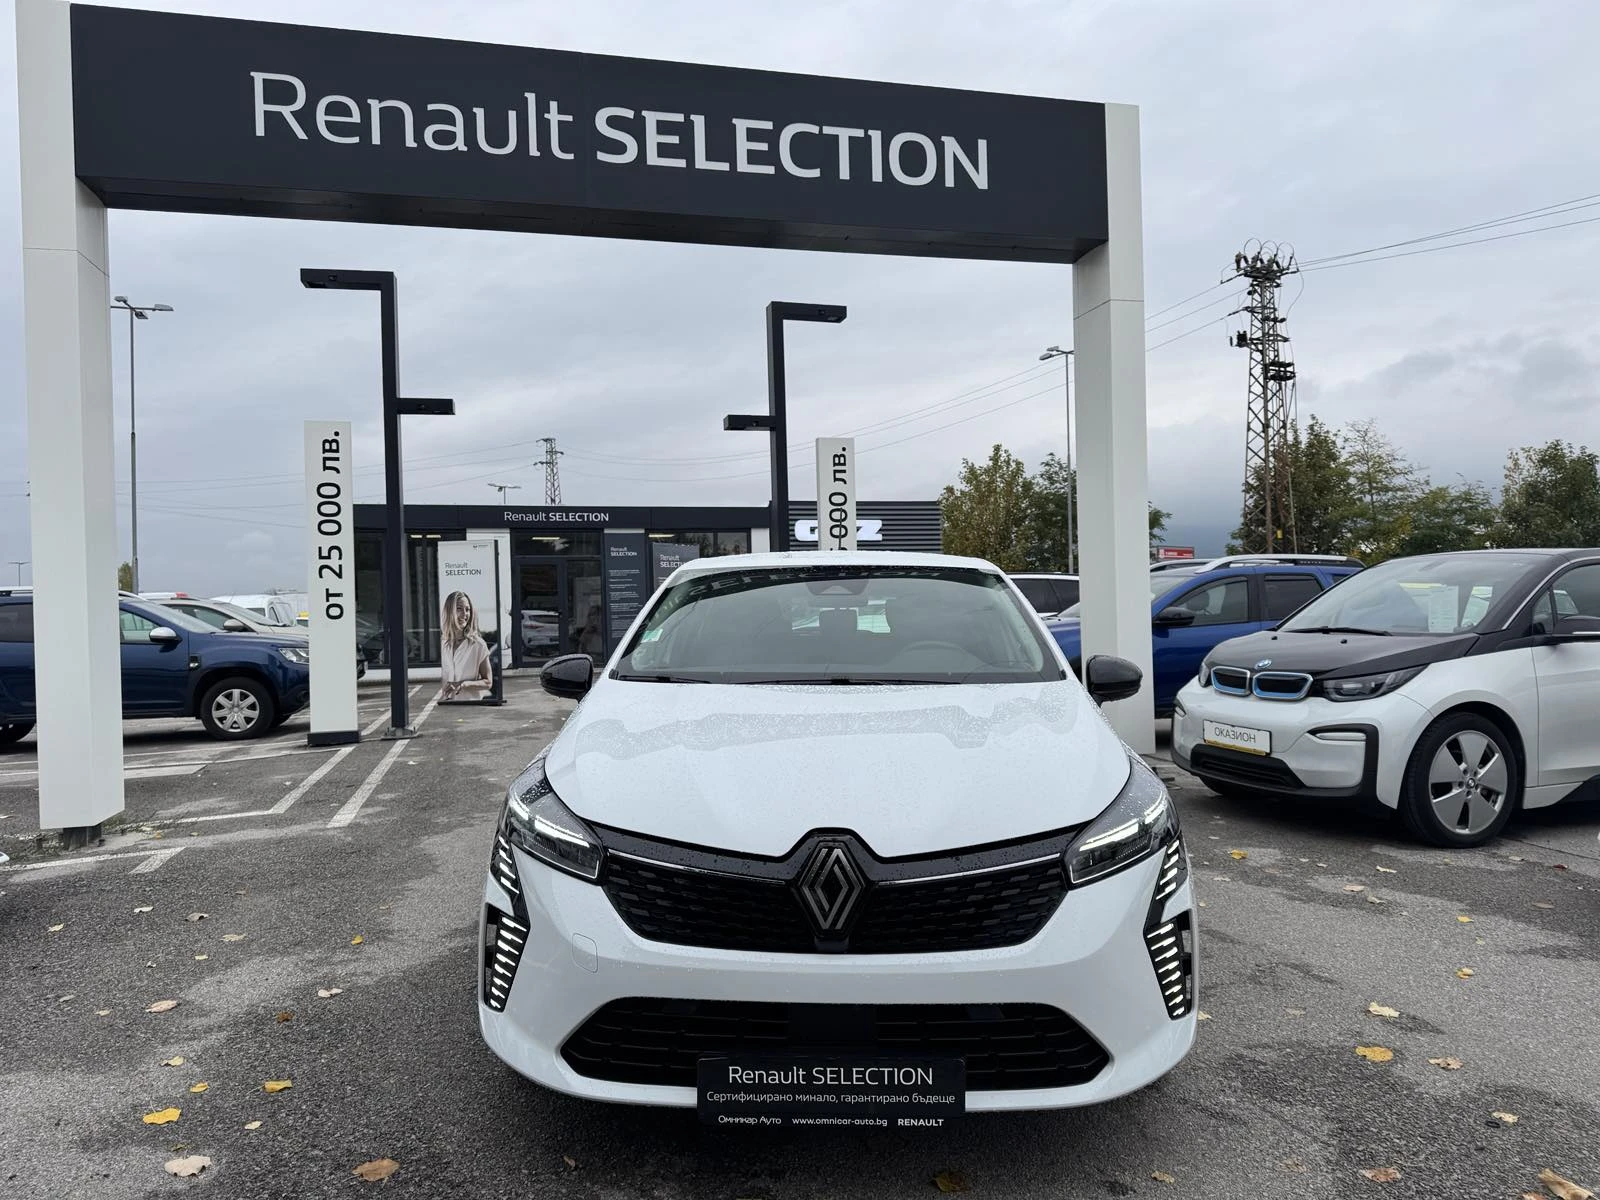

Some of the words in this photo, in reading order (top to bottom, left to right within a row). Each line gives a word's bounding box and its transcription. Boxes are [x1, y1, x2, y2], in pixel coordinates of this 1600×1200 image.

[250, 71, 575, 160] Renault
[595, 105, 990, 190] SELECTION
[322, 431, 341, 474] лв.
[833, 447, 847, 485] лв.
[316, 482, 342, 536] 000
[504, 511, 547, 521] Renault
[549, 512, 609, 522] SELECTION
[829, 492, 848, 539] 000
[318, 545, 343, 579] 25
[445, 569, 482, 577] SELECTION
[325, 588, 344, 620] от
[1214, 727, 1257, 743] ОКАЗИОН
[728, 1066, 807, 1085] Renault
[812, 1067, 933, 1086] SELECTION
[706, 1091, 793, 1104] Сертифицирано
[795, 1093, 839, 1104] минало,
[841, 1094, 910, 1105] гарантирано
[912, 1092, 956, 1105] бъдеще
[718, 1115, 758, 1126] Омникар
[759, 1116, 782, 1126] Ауто
[792, 1117, 888, 1127] www.omnicar-auto.bg
[897, 1118, 944, 1127] RENAULT
